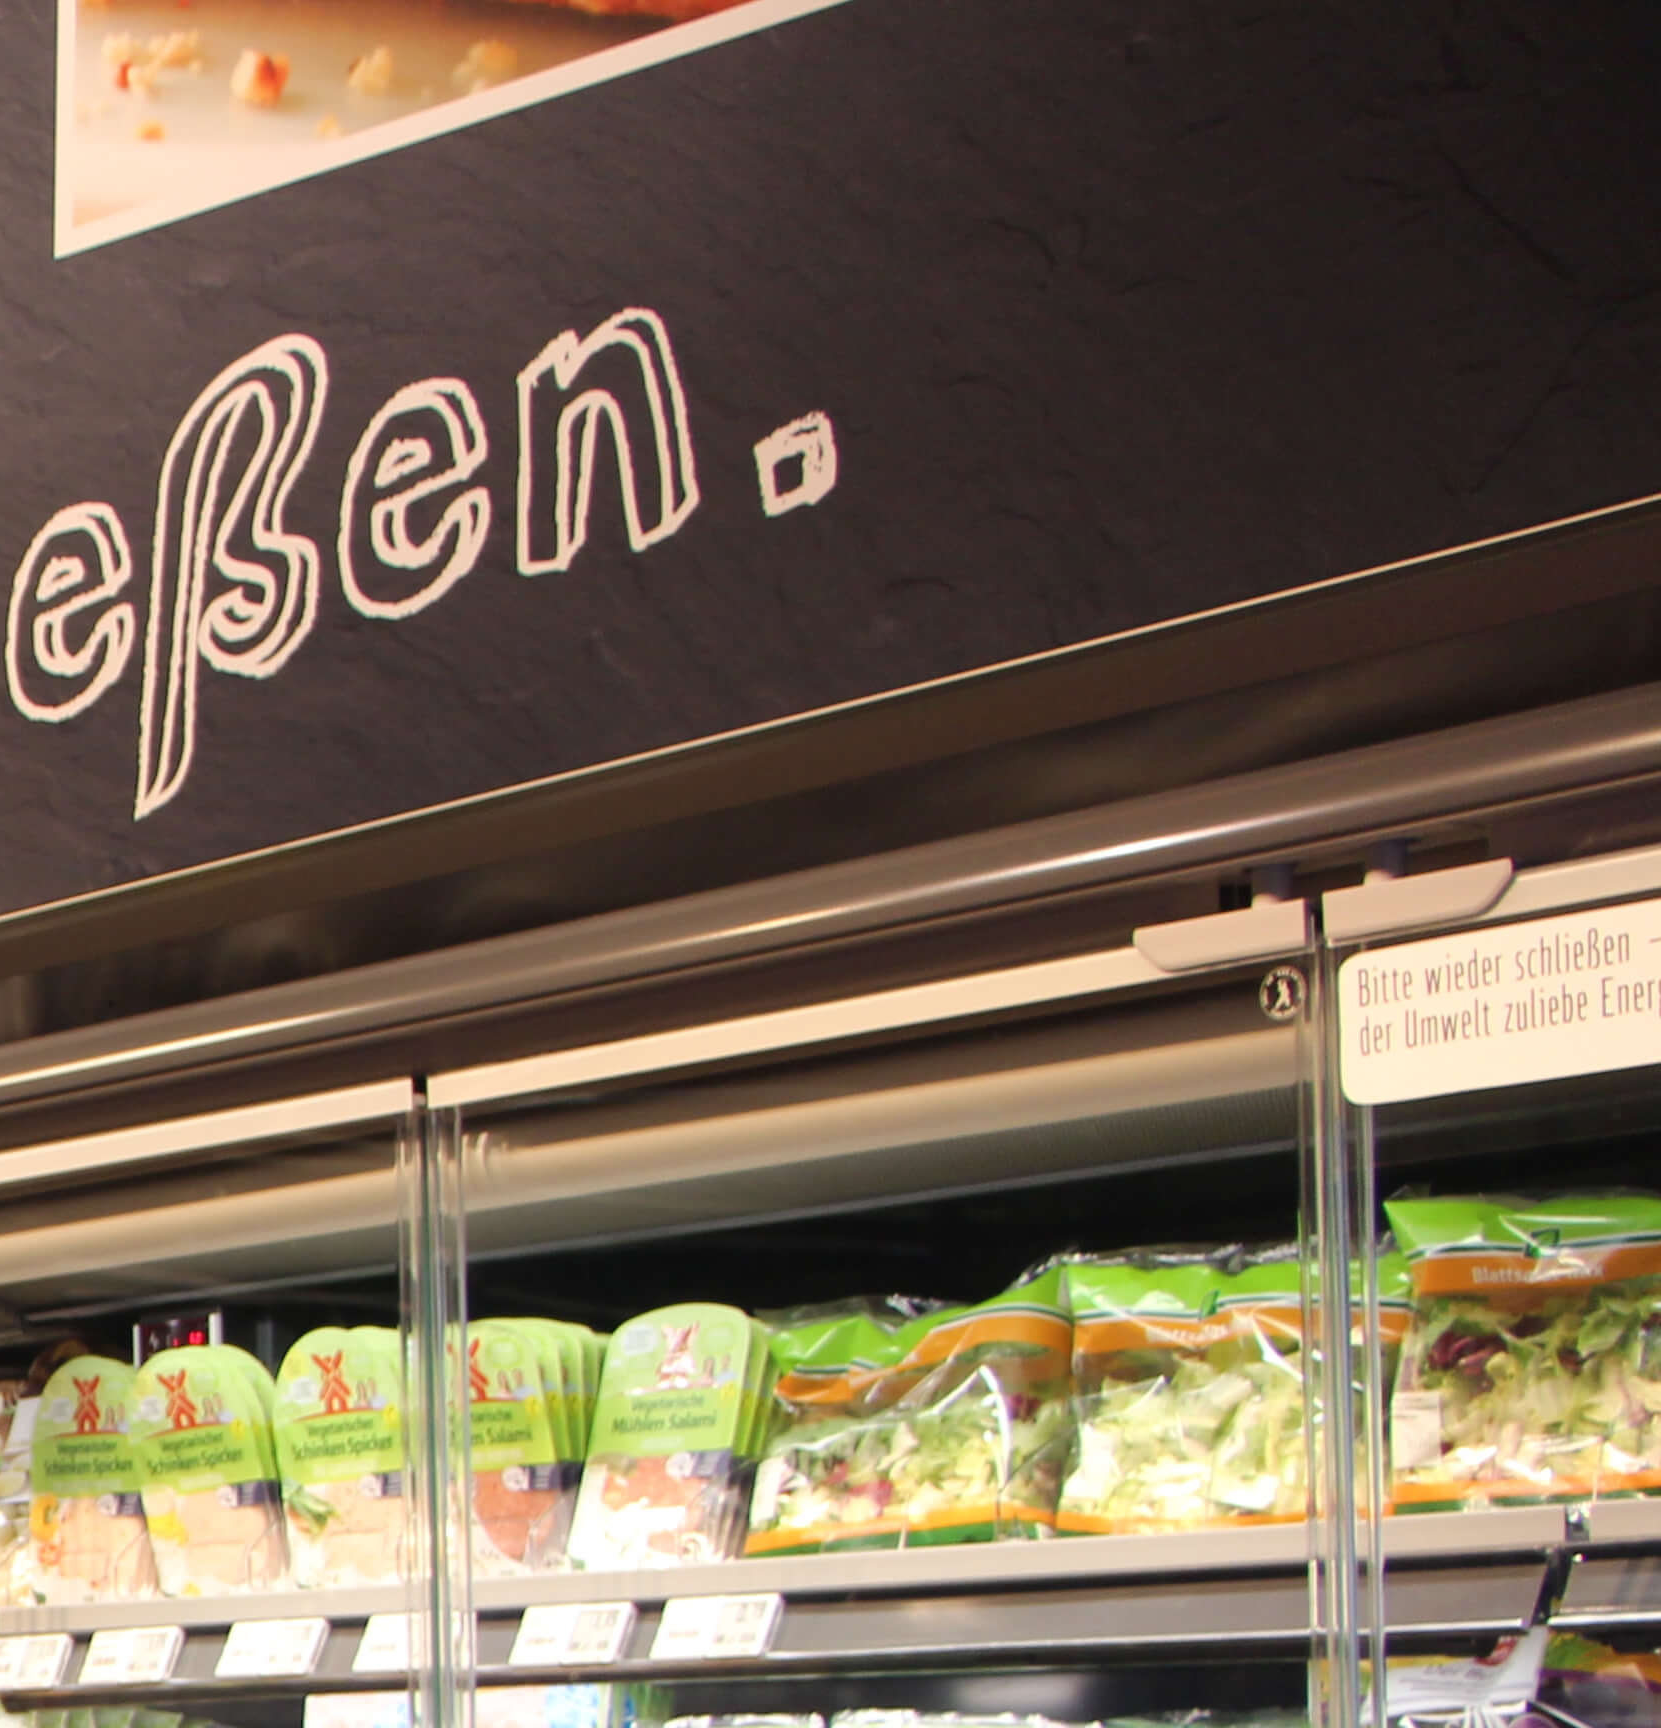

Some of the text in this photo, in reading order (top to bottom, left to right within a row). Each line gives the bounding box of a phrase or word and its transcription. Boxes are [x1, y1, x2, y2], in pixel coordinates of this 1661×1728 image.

[1357, 928, 1631, 1007] Bitte wieder schließen
[1360, 1017, 1393, 1057] der
[1404, 1001, 1492, 1047] Umwelt
[1503, 988, 1588, 1034] zuliebe
[667, 1411, 718, 1430] Salami
